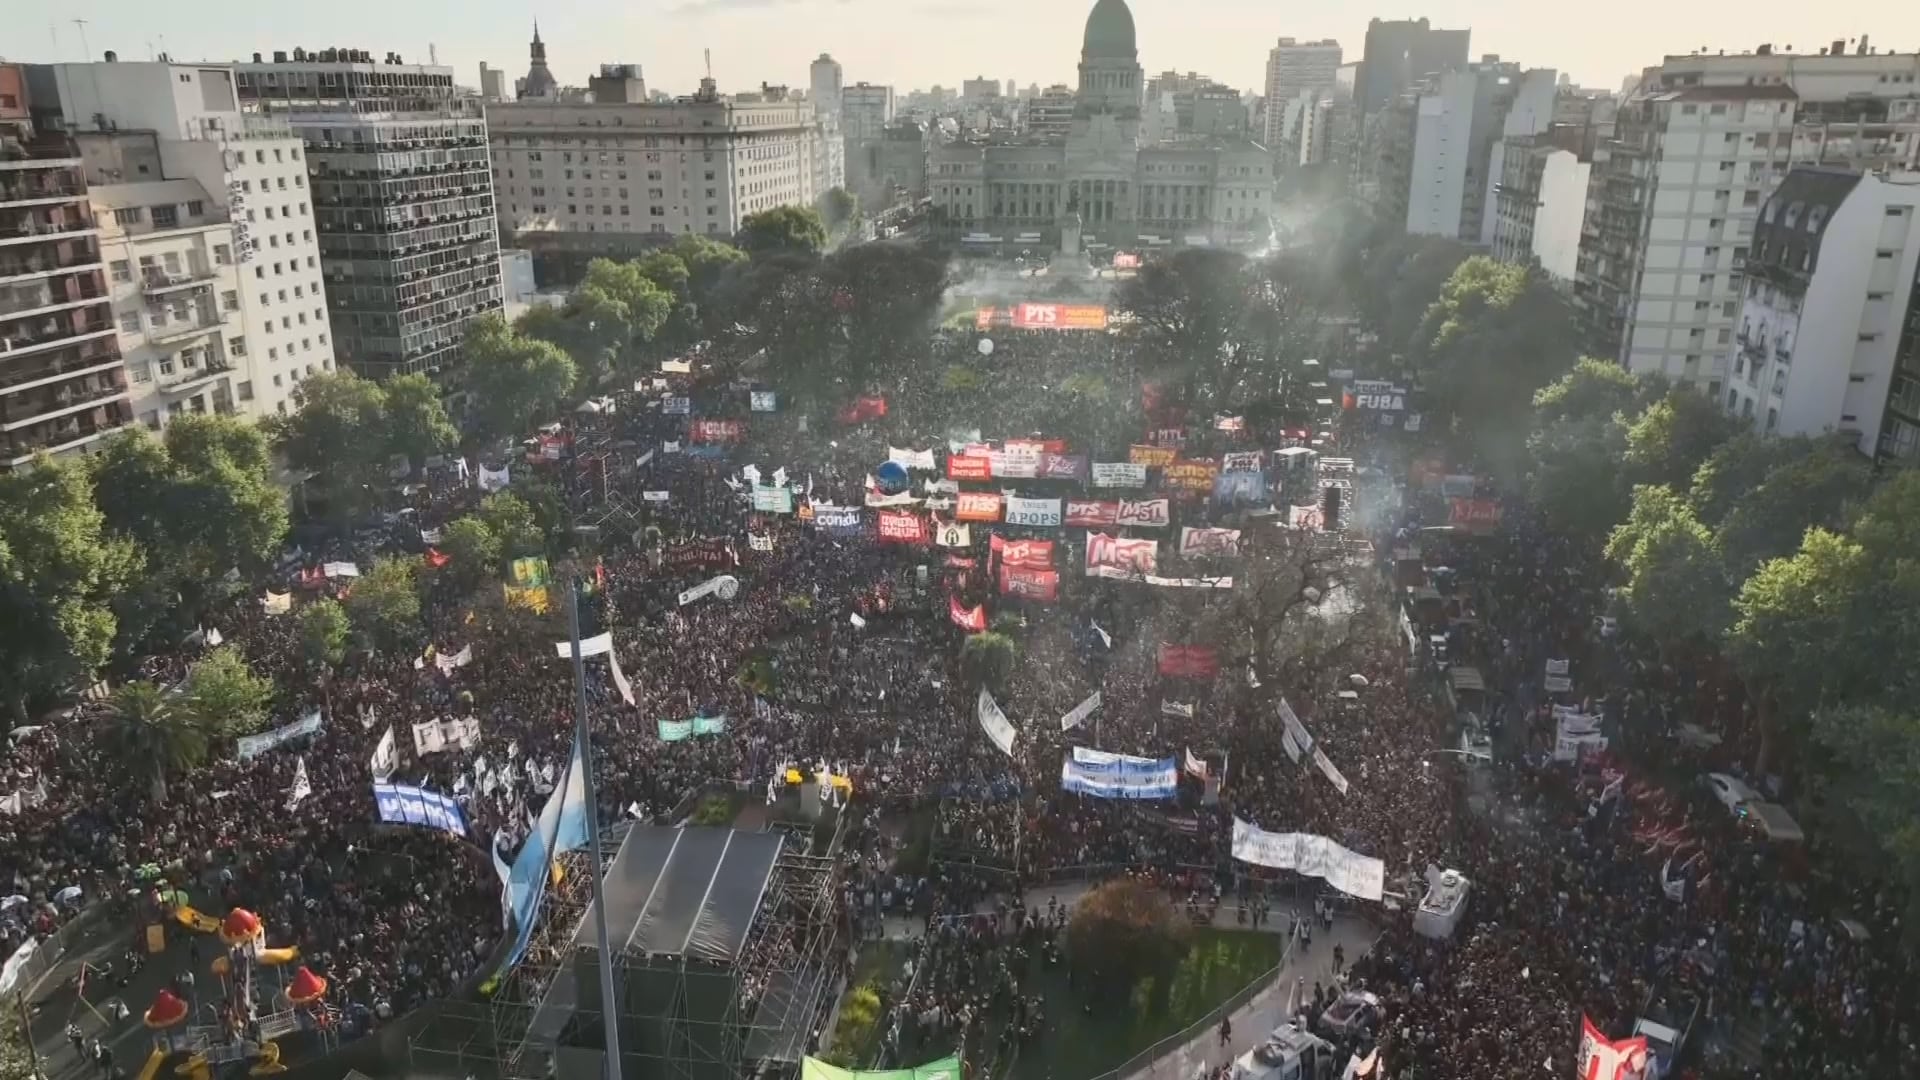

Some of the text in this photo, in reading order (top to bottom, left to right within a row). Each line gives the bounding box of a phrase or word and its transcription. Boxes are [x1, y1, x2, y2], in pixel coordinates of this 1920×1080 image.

[1024, 305, 1056, 322] PTS
[1356, 394, 1404, 410] FUBA
[1157, 429, 1187, 440] MTL
[1162, 465, 1218, 478] PARTIDO
[959, 496, 999, 513] mas
[1066, 502, 1100, 516] PTS
[1123, 501, 1165, 520] MST
[1007, 511, 1059, 525] APOPS
[1002, 542, 1029, 558] PTS
[1090, 538, 1154, 569] MST
[1008, 580, 1028, 594] PTS
